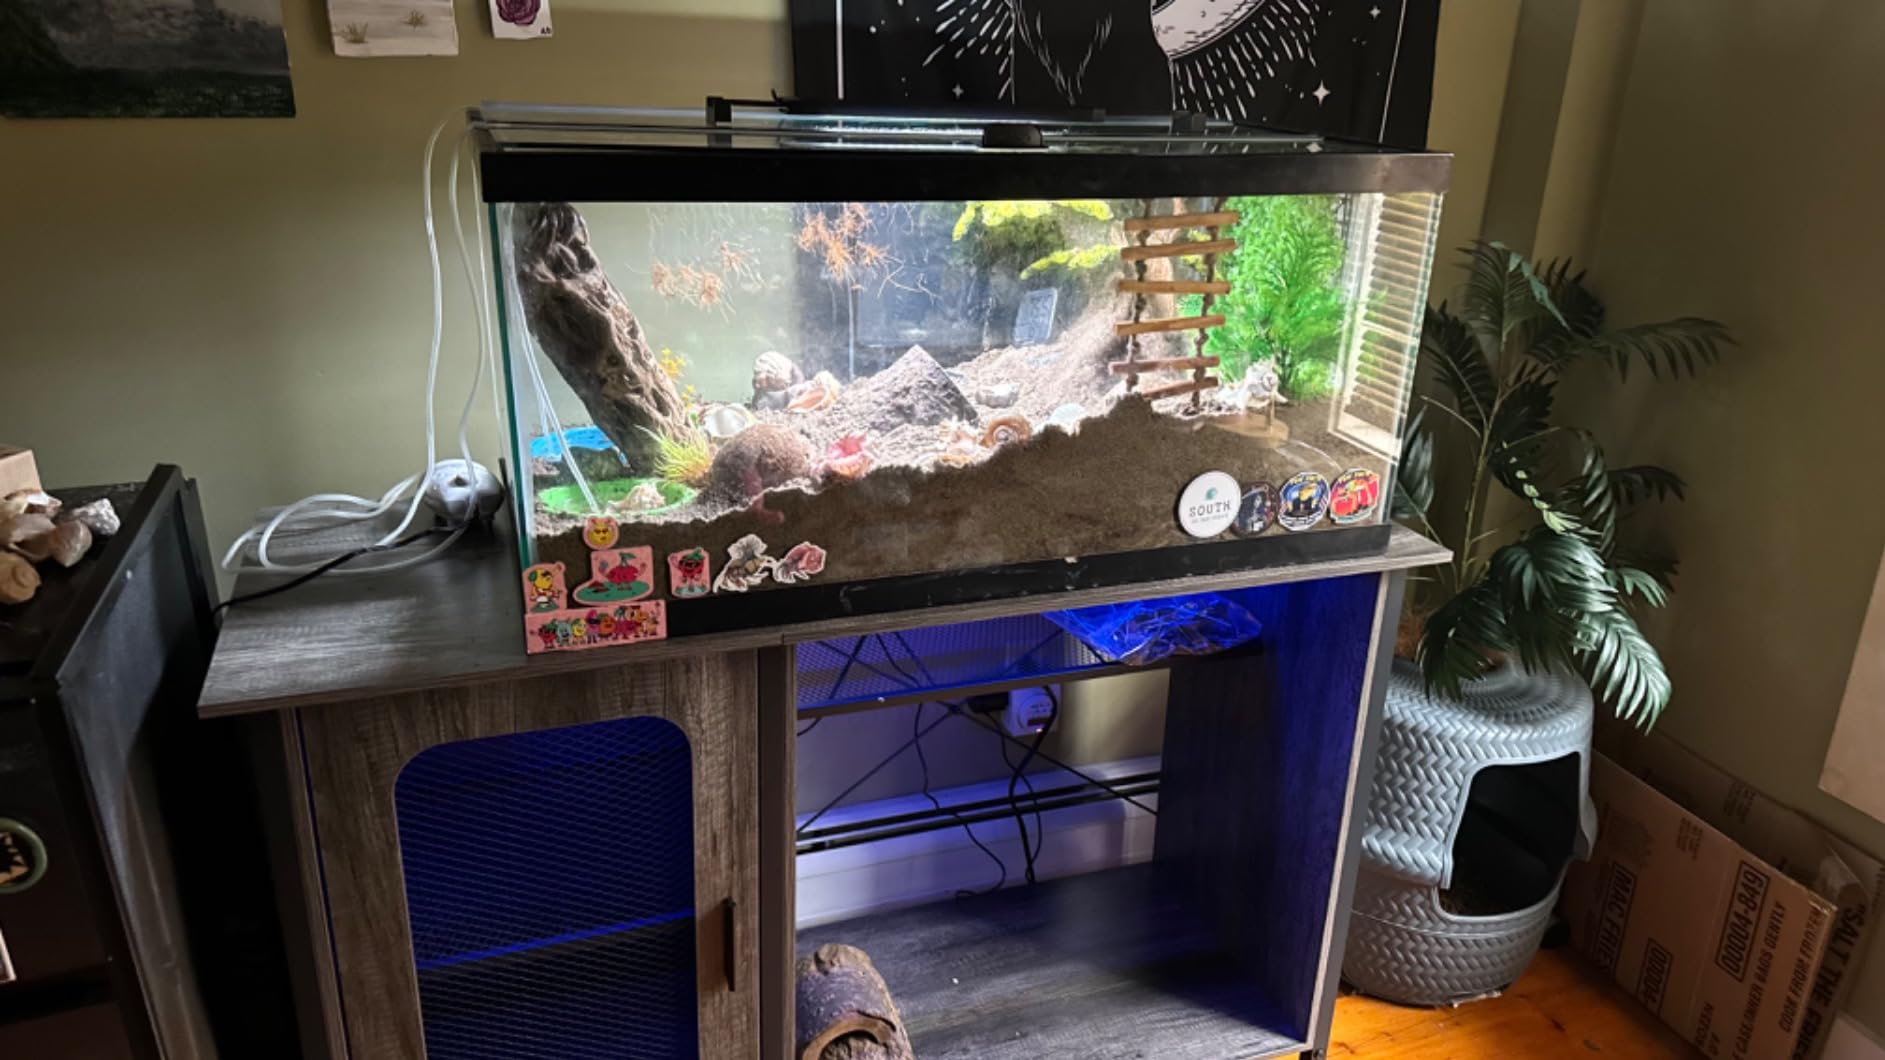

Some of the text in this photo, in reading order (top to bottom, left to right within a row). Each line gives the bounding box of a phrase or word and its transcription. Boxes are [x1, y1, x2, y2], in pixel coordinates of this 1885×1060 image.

[1189, 500, 1231, 517] SOUTH
[1596, 869, 1631, 973] MAC FRIES
[1720, 870, 1764, 973] 00004-849
[1764, 901, 1785, 949] GENTLY
[1756, 948, 1773, 983] BAGS
[1812, 963, 1843, 1008] THE
[1778, 996, 1796, 1033] COOK
[1789, 957, 1809, 998] FROM
